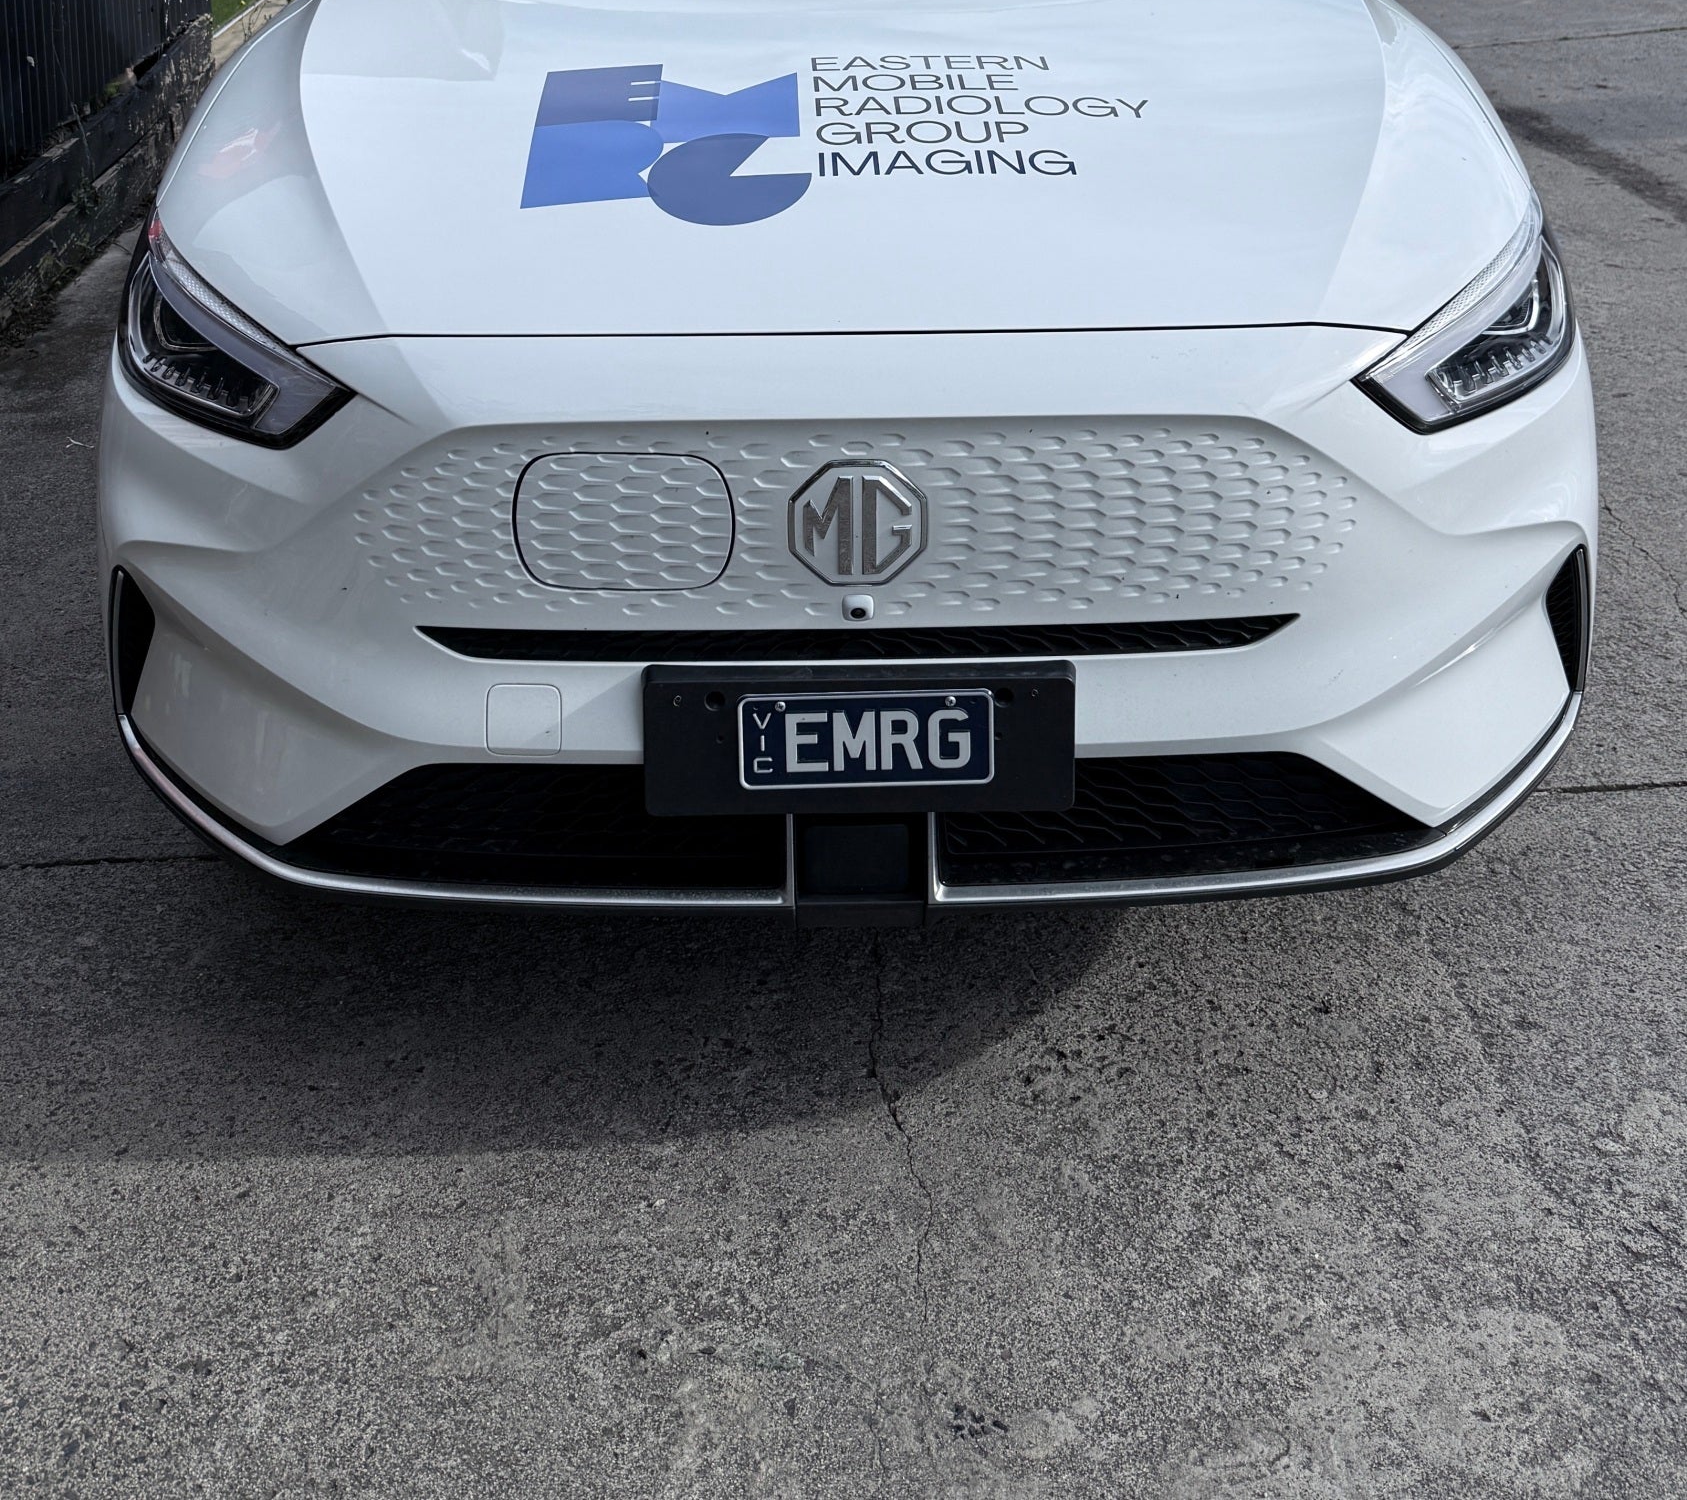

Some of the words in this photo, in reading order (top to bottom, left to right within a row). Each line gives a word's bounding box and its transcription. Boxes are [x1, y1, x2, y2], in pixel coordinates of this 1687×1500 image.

[810, 55, 1050, 72] EASTERN
[812, 74, 1019, 93] MOBILE
[814, 94, 1149, 119] RADIOLOGY
[815, 120, 1029, 146] GROUP
[818, 149, 1077, 177] IMAGING
[803, 475, 913, 576] MG
[752, 712, 774, 775] VIC
[785, 708, 972, 774] EMRG
